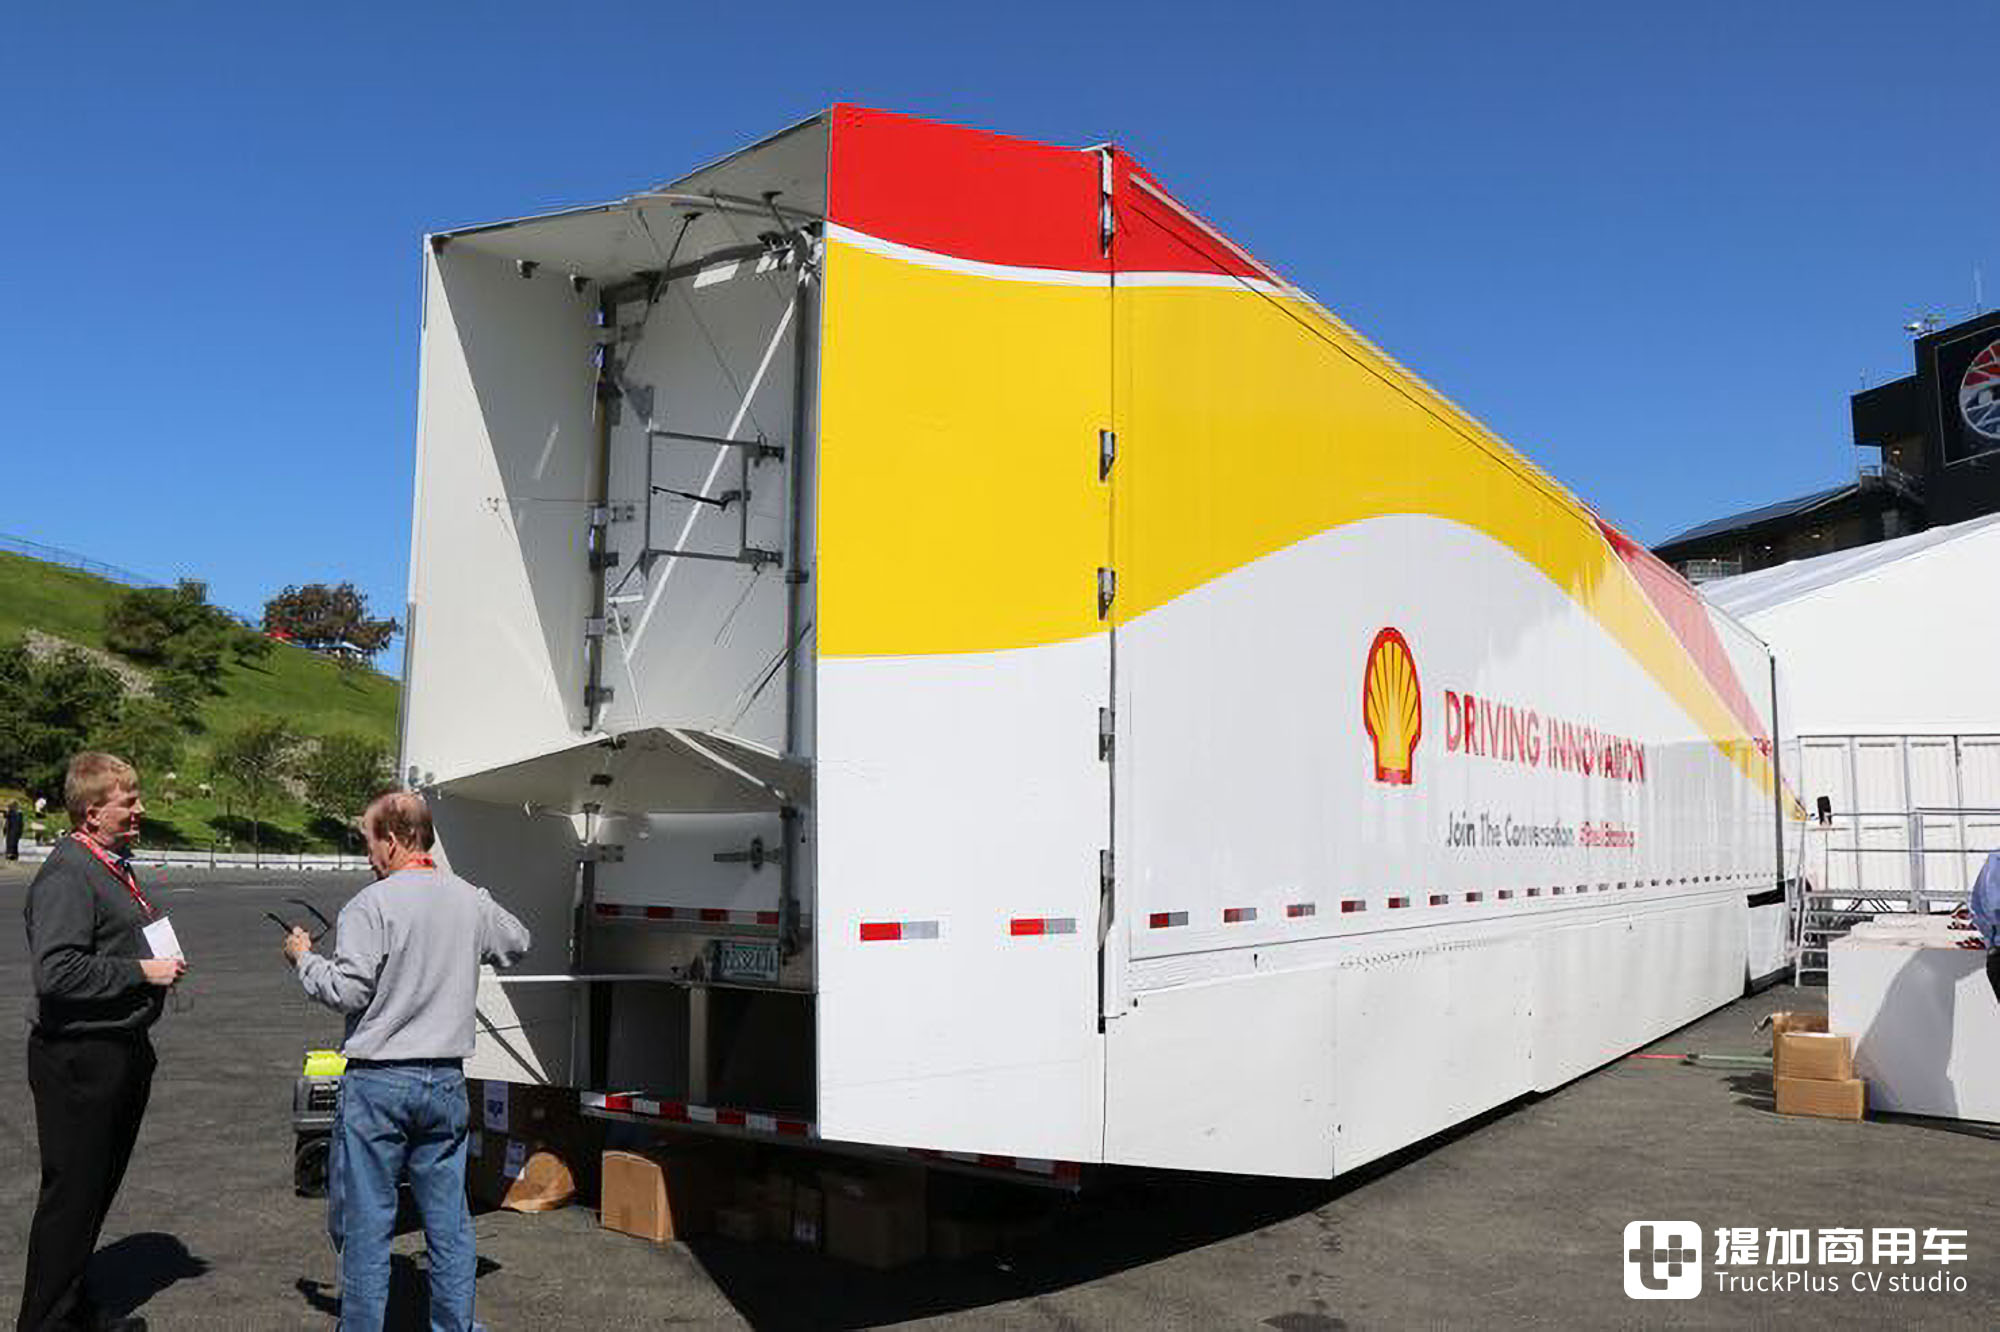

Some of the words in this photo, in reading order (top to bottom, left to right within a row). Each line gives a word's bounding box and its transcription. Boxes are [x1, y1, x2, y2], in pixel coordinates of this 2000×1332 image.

[1445, 690, 1540, 766] DRIVING
[1546, 715, 1646, 784] INNOVATION
[1446, 811, 1476, 847] Join
[1480, 811, 1501, 847] The
